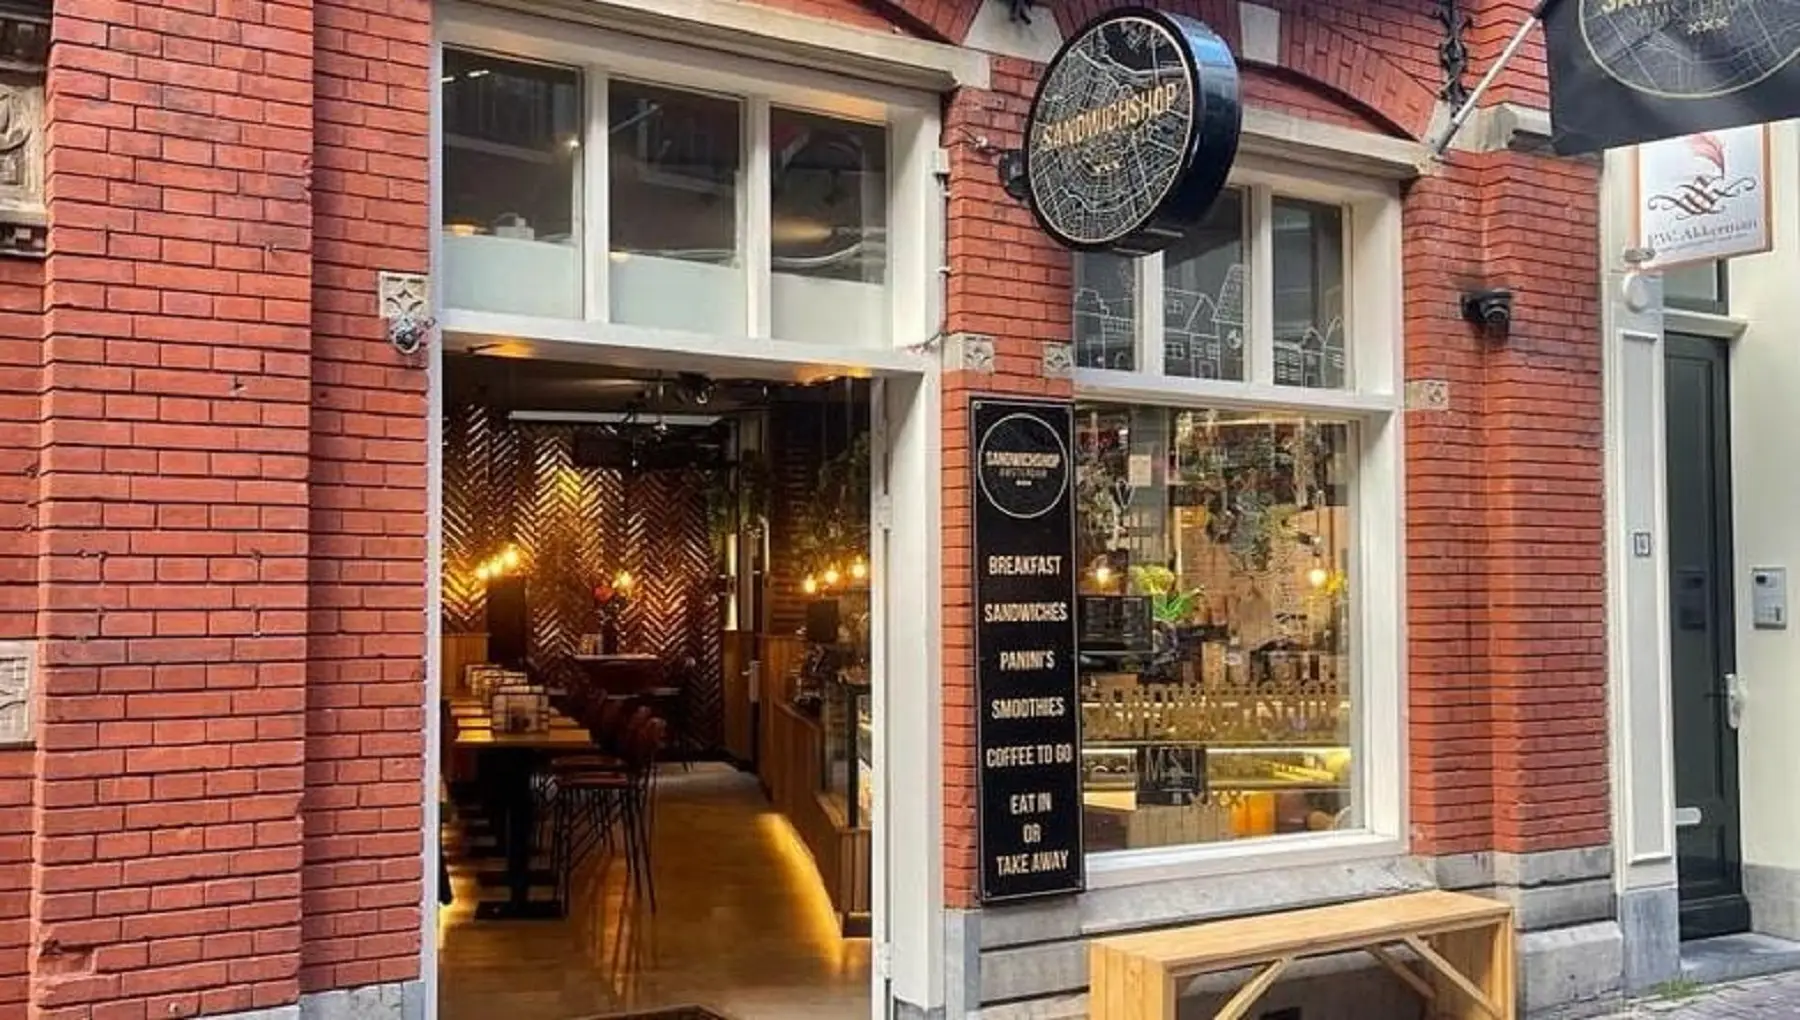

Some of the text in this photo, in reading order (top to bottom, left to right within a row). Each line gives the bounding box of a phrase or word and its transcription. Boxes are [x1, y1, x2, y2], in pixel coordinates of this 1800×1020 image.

[1043, 83, 1177, 149] SANDWICHSHOP
[988, 555, 1062, 575] BREAKFAST
[984, 602, 1068, 623] SANDWICHES
[1000, 650, 1055, 671] PANINI'S
[991, 697, 1065, 719] SMOOTHIES
[986, 744, 1073, 768] COFFEE TO GO
[1009, 792, 1052, 815] EAT IN
[1022, 823, 1041, 843] OR
[996, 850, 1069, 877] TAKE AWAY
